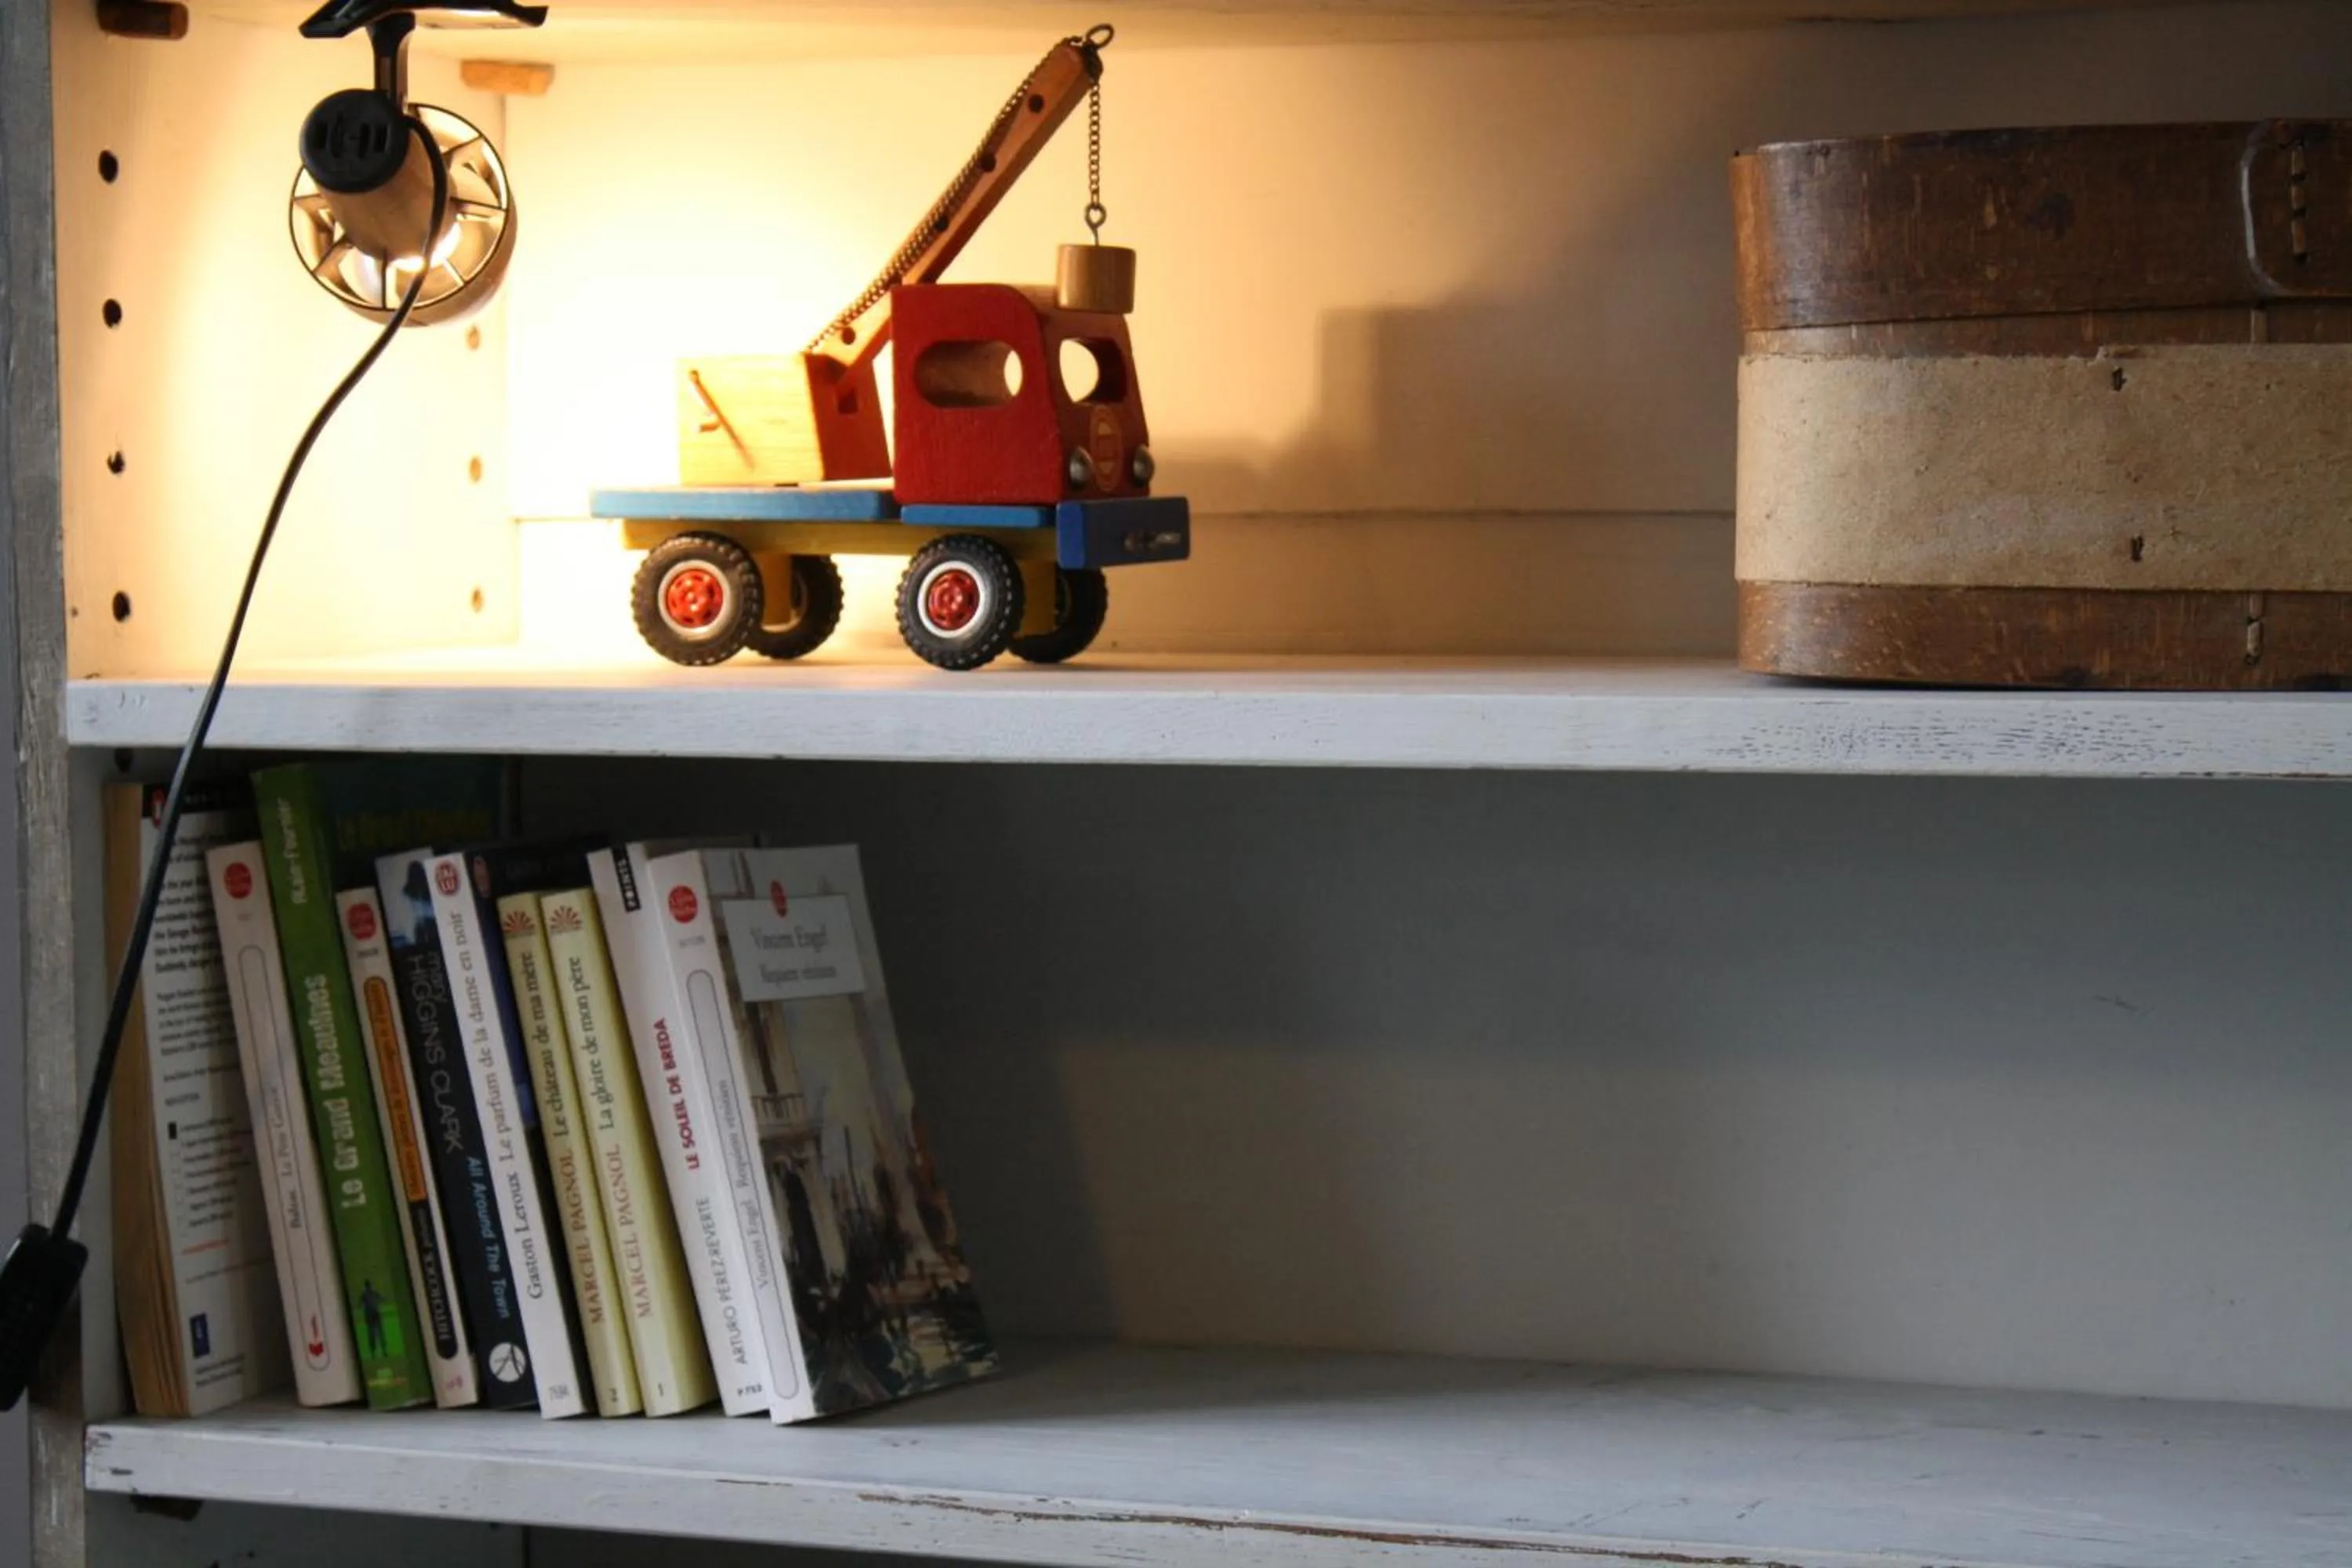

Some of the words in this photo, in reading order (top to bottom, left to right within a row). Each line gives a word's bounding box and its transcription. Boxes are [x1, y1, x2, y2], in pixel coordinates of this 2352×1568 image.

[449, 913, 467, 946] noir
[460, 951, 474, 971] en
[521, 953, 539, 992] mère
[568, 957, 591, 992] père
[464, 976, 483, 1022] dame
[530, 995, 544, 1022] ma
[576, 995, 594, 1033] mon
[407, 954, 446, 1065] HIGGINS
[430, 1069, 464, 1154] CLARK
[474, 1028, 488, 1043] la
[531, 1025, 549, 1044] de
[579, 1036, 598, 1054] de
[654, 1018, 676, 1069] BREDA
[477, 1048, 493, 1068] de
[541, 1049, 564, 1113] château
[589, 1058, 615, 1105] gloire
[666, 1076, 682, 1094] DE
[485, 1072, 513, 1134] parfum
[597, 1109, 615, 1131] La
[322, 1098, 359, 1171] Grand
[552, 1117, 569, 1138] Le
[673, 1100, 695, 1149] SOLEIL
[467, 1156, 482, 1176] All
[498, 1138, 514, 1163] Le
[685, 1154, 700, 1170] LE
[341, 1178, 366, 1208] Le
[506, 1172, 530, 1234] Leroux
[559, 1148, 587, 1232] PAGNOL
[605, 1144, 634, 1227] PAGNOL
[472, 1181, 496, 1239] Around
[485, 1243, 500, 1272] The
[521, 1238, 543, 1300] Gaston
[622, 1233, 651, 1318] MARCEL
[492, 1278, 510, 1318] Town
[577, 1239, 603, 1324] MARCEL
[723, 1305, 748, 1365] ARTURO
